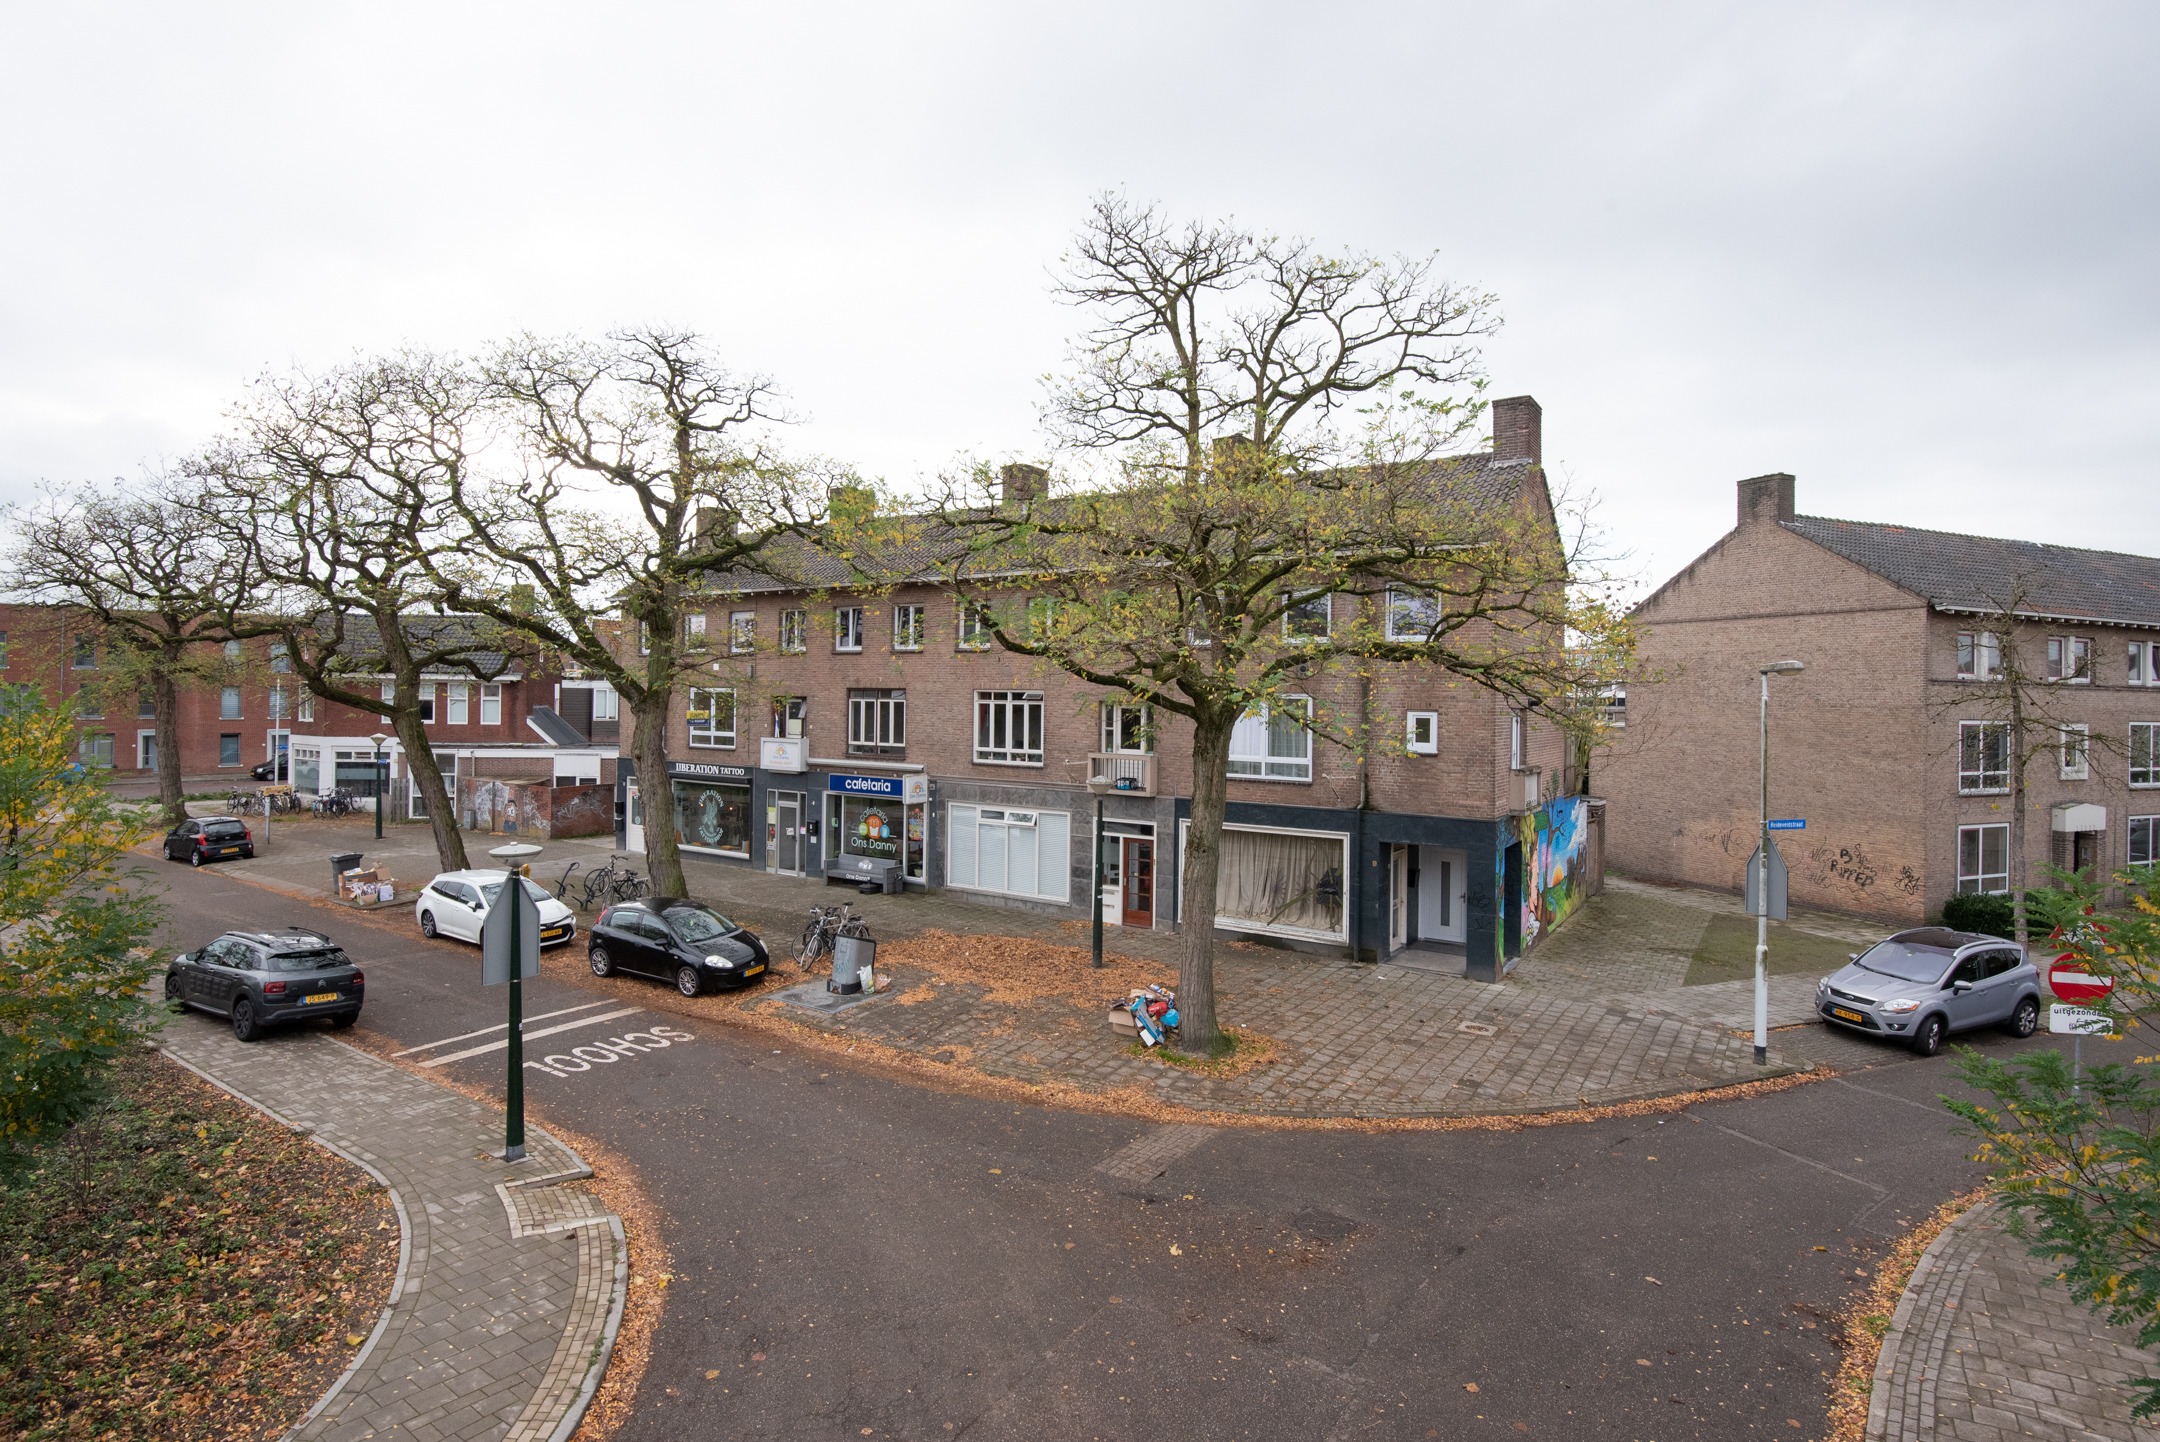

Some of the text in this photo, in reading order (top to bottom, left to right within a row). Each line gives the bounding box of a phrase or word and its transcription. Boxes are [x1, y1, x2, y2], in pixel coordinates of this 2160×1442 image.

[675, 762, 745, 776] LIBERATION TATTOO
[845, 778, 891, 792] cafetaria
[860, 806, 889, 824] cafetaria
[851, 837, 897, 853] Ons Danny
[523, 1026, 695, 1078] SCHOOL
